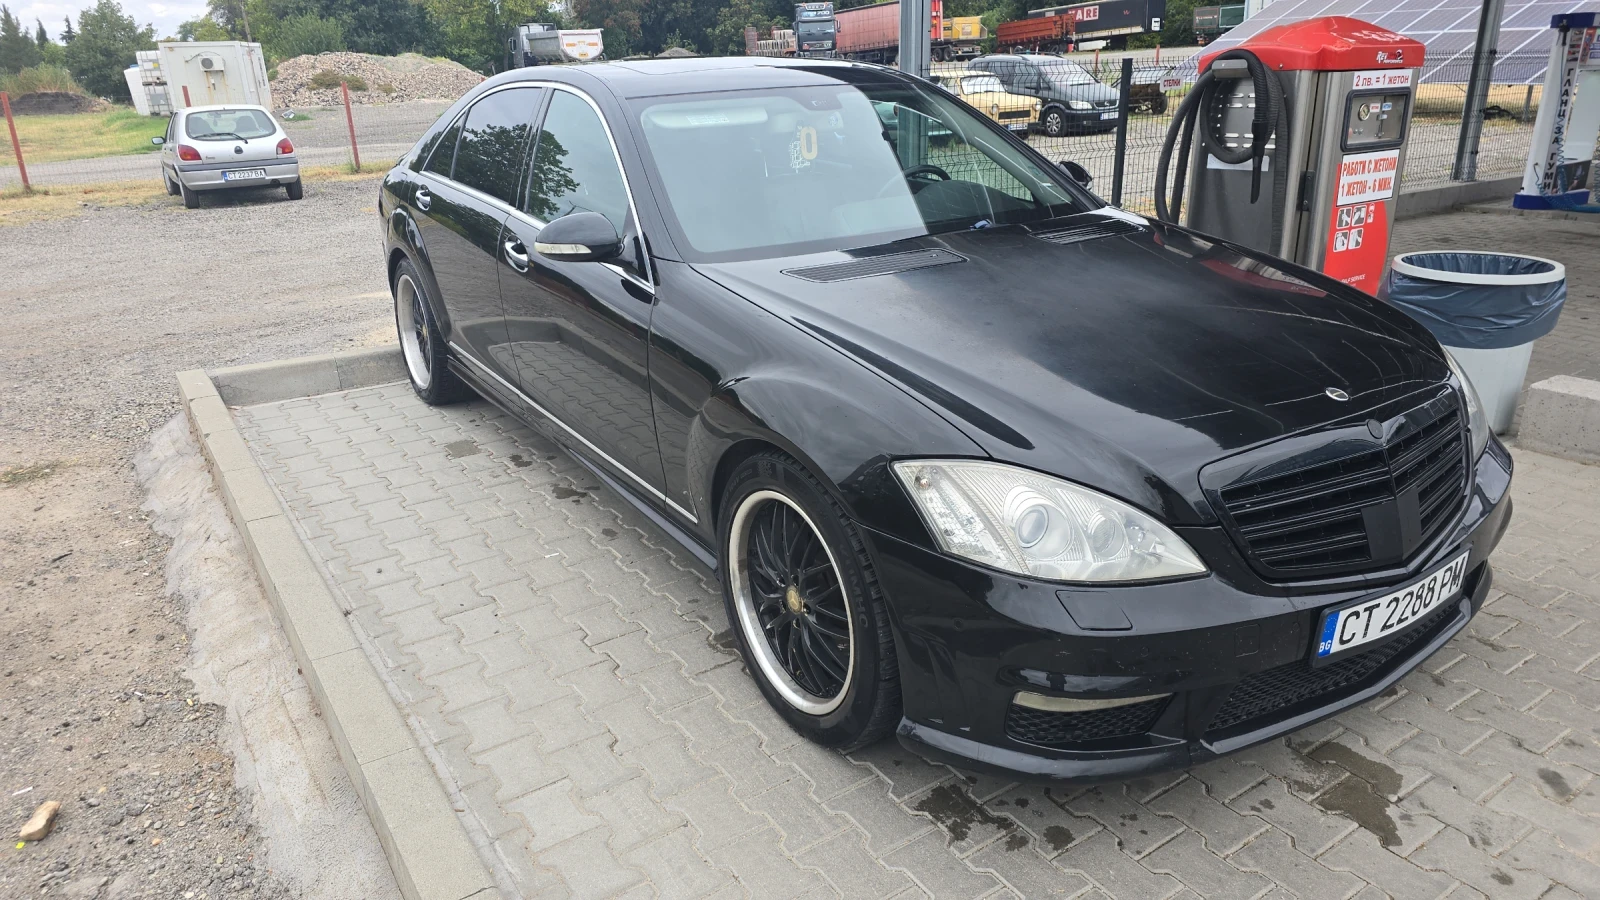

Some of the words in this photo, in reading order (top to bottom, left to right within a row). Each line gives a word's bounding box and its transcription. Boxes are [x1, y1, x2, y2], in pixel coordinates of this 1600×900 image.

[1355, 75, 1361, 87] 2
[1361, 77, 1374, 87] лв.
[1382, 74, 1387, 85] 1
[1387, 75, 1410, 85] жетон
[1557, 68, 1574, 119] ГЛАНЦ
[1552, 126, 1561, 144] ЗА
[238, 171, 254, 179] 2237
[1342, 160, 1367, 177] РАБОТИ
[1367, 159, 1373, 174] С
[1372, 156, 1397, 173] ЖЕТОНИ
[1543, 153, 1557, 190] ГУМИ
[1345, 180, 1367, 197] ЖЕТОН
[1372, 178, 1377, 193] 6
[1350, 274, 1366, 282] SERVICE
[1338, 602, 1380, 646] CT
[1380, 575, 1438, 633] 2288
[1437, 555, 1466, 602] PM
[1319, 640, 1332, 653] BG
